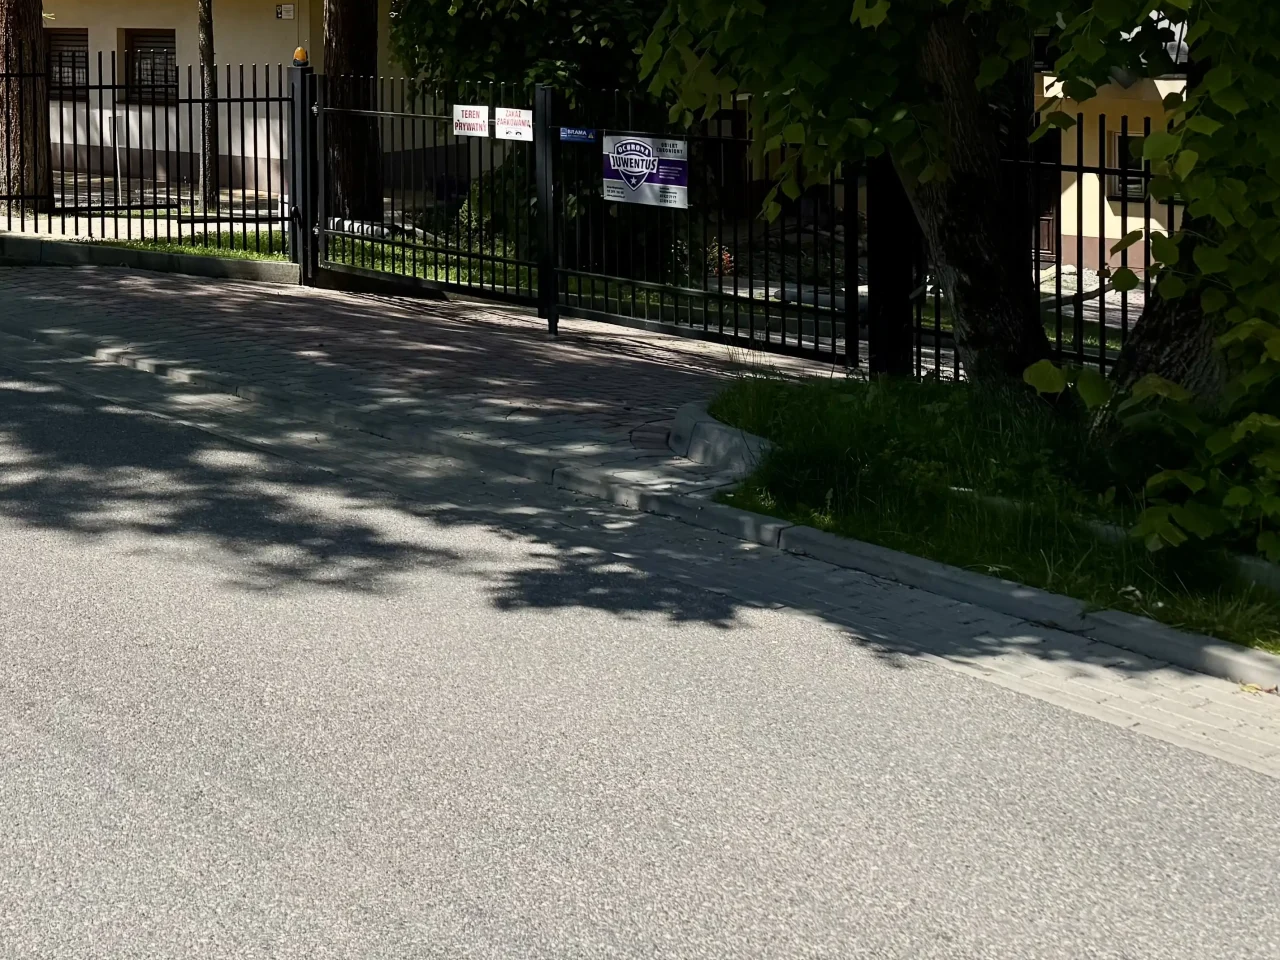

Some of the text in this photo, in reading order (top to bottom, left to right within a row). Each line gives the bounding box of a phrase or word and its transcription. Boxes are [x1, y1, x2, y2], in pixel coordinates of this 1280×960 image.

[461, 109, 480, 118] TEREN
[455, 121, 487, 132] PRYWATNY
[610, 155, 657, 171] JUWENTUS
